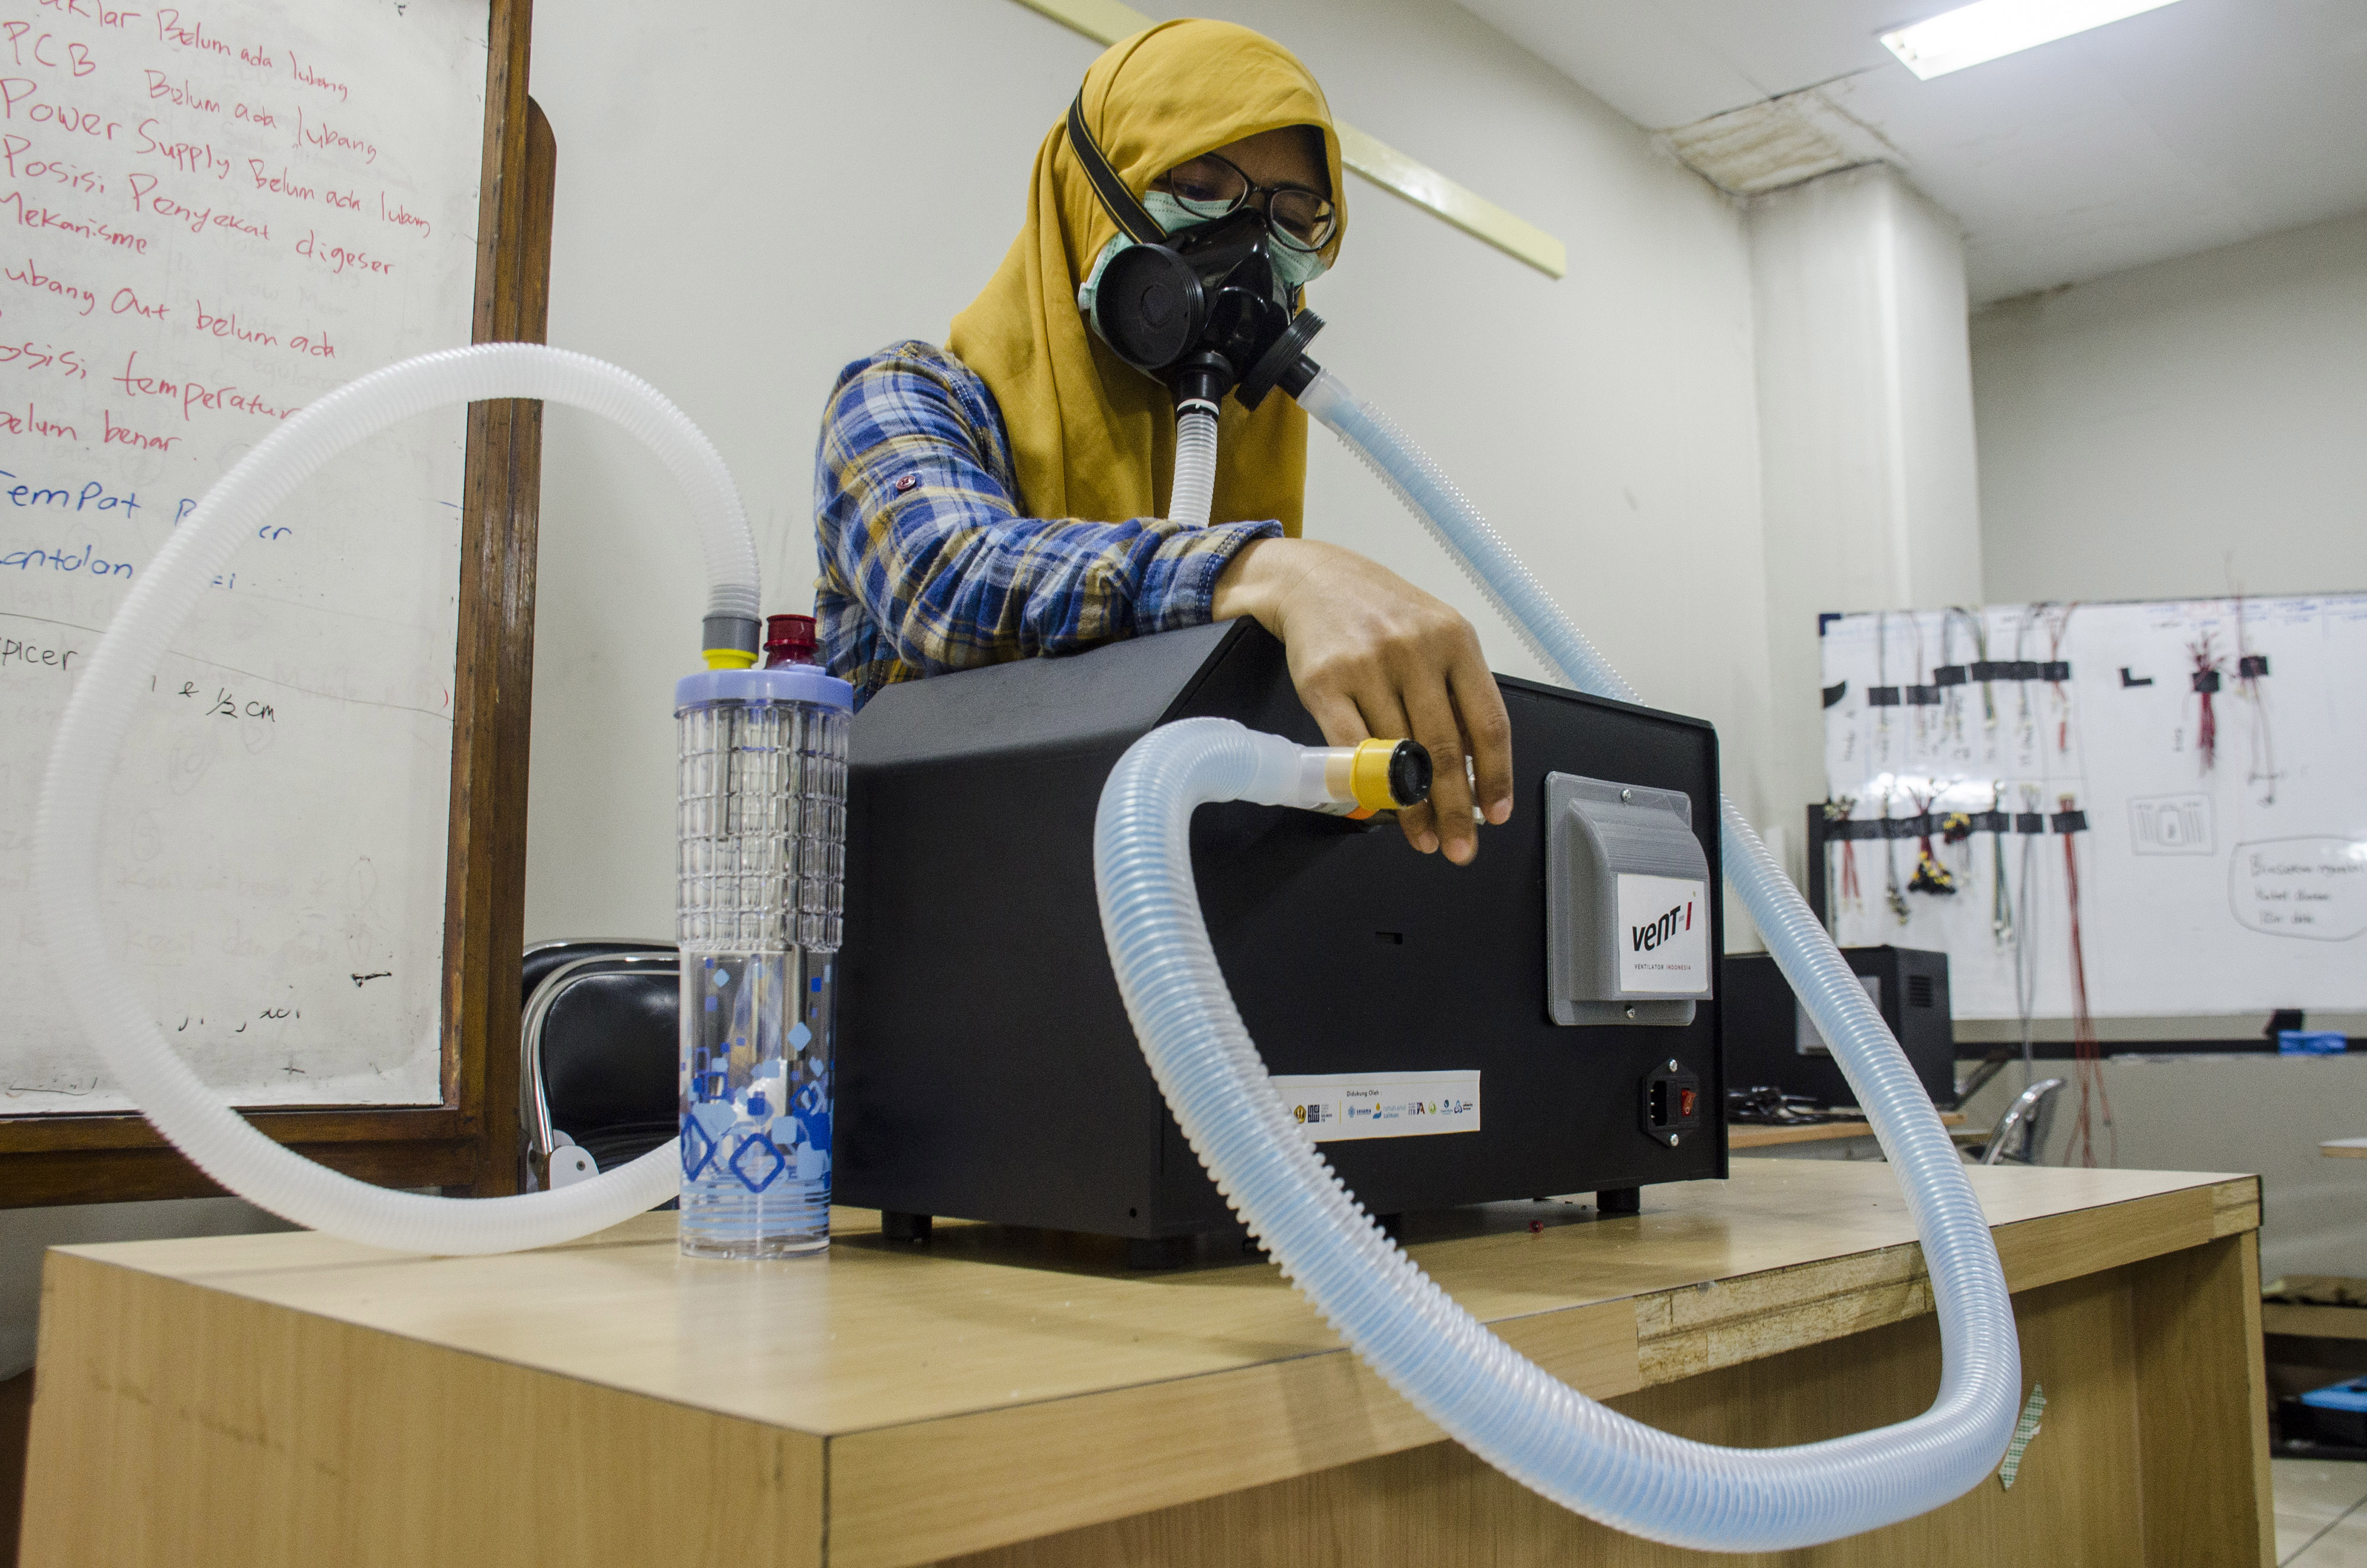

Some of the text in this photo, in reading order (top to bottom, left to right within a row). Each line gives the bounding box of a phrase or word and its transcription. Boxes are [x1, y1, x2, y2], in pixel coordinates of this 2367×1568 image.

[2, 21, 377, 163] PCB Belum ada lubang
[157, 9, 231, 56] Belum
[240, 45, 272, 68] ada
[289, 51, 348, 99] lubang
[0, 78, 122, 141] Power
[137, 118, 230, 179] Supply
[249, 159, 314, 199] Belum
[326, 191, 360, 211] ada
[2, 134, 394, 276] Posisi Penyekat digeser
[196, 301, 277, 346] belum
[290, 331, 335, 359] ada
[104, 409, 182, 451] benar
[112, 351, 304, 421] temperatur
